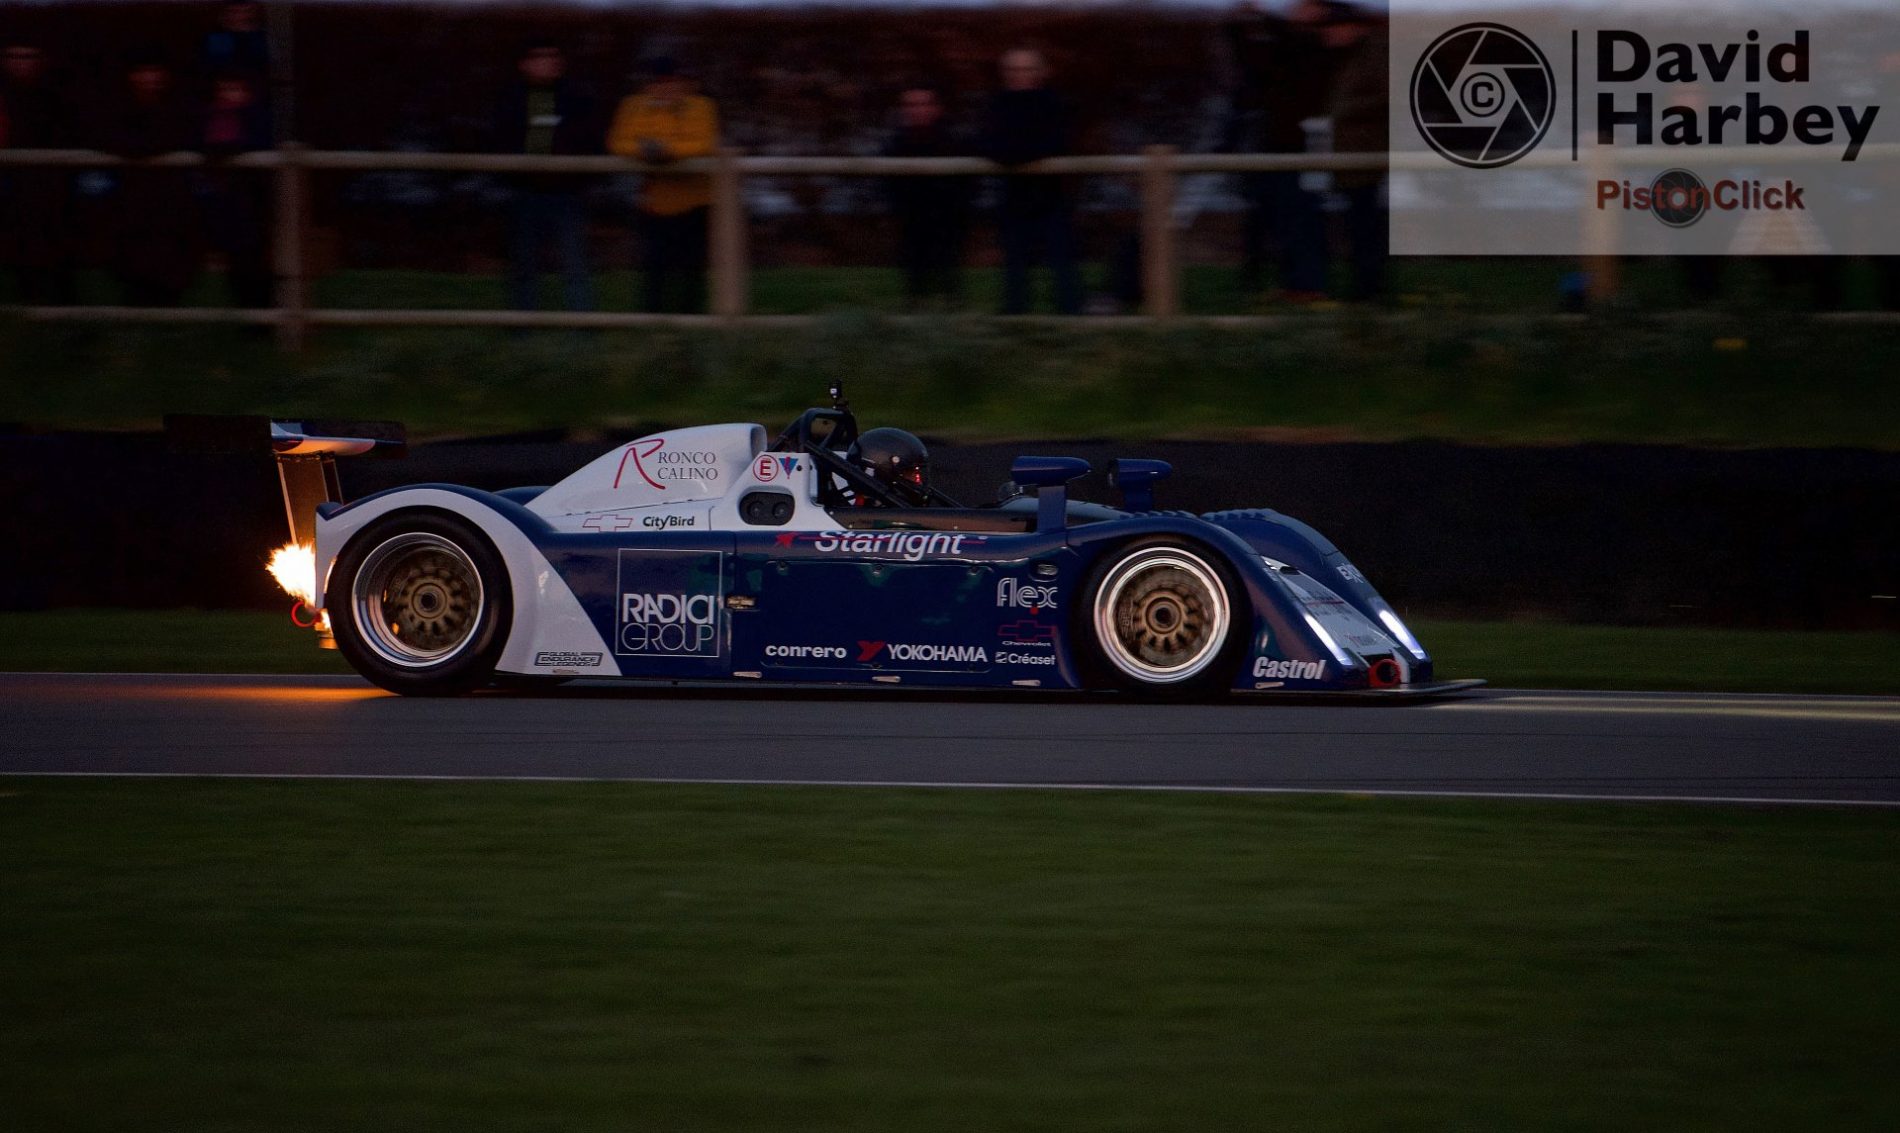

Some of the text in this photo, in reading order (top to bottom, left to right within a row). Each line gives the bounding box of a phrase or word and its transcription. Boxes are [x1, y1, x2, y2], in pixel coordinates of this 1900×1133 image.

[657, 451, 717, 465] RONCO
[657, 467, 719, 481] CALINO
[642, 515, 695, 530] CityBird
[814, 530, 965, 561] Starlight
[996, 577, 1059, 609] flex
[622, 593, 715, 624] RADICI
[620, 623, 715, 652] GROUP
[765, 645, 847, 659] conrero
[887, 644, 988, 663] YOKOHAMA
[1008, 653, 1056, 665] Créaset
[1252, 656, 1327, 680] Castrol
